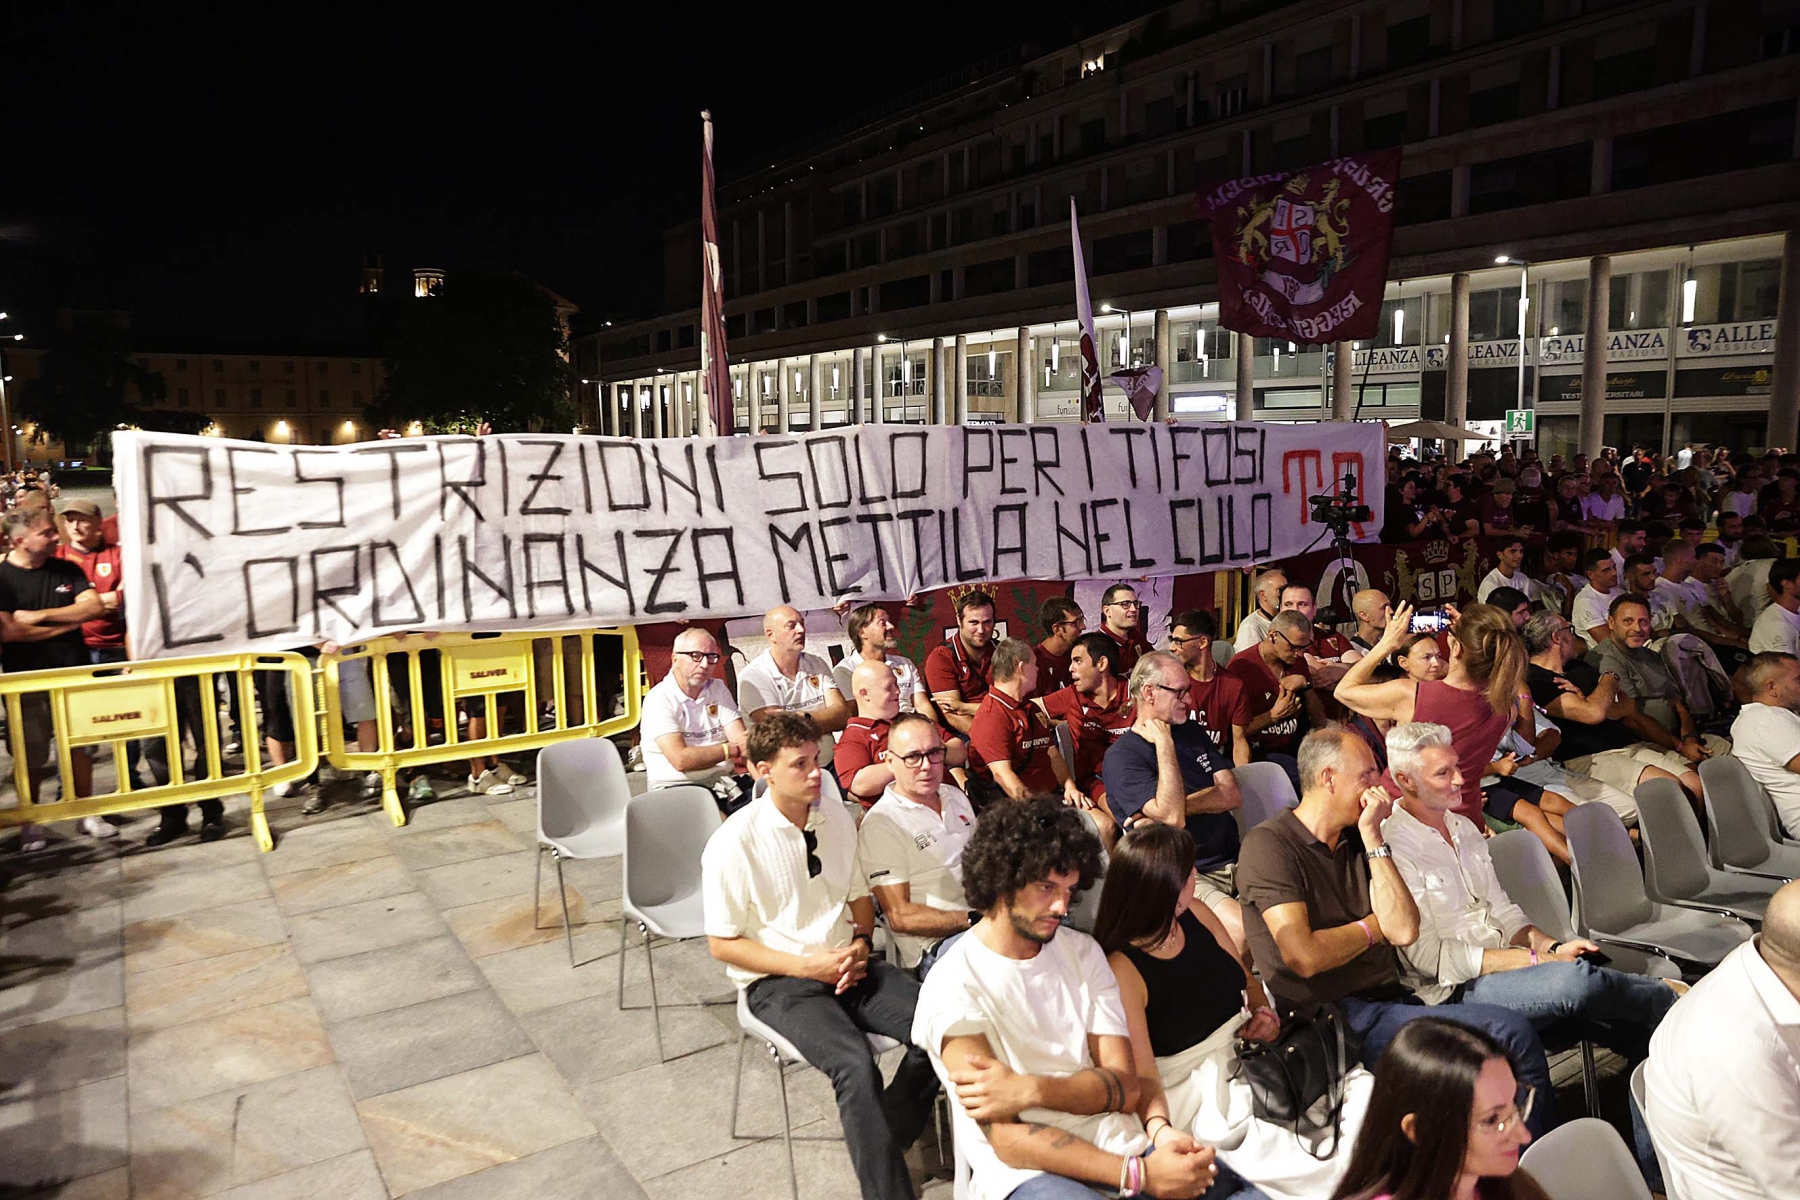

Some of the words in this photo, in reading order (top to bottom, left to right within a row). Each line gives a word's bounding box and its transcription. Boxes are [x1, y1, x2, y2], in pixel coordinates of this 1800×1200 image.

[1564, 333, 1665, 353] ALANZA
[1714, 324, 1777, 343] ALLE
[1355, 350, 1419, 366] LLEANZA
[1445, 342, 1529, 359] LEANZA
[1560, 391, 1582, 400] TEST
[143, 439, 724, 544] RESTRIZIONI
[754, 431, 929, 515] SOLO
[962, 426, 1065, 498] PER
[1080, 427, 1095, 491] I
[1110, 426, 1266, 494] TIFOSI
[150, 526, 746, 649] L'ORDINANZA
[768, 502, 1029, 602] METTILA
[1056, 498, 1156, 580] NEL
[1171, 493, 1273, 565] CULO
